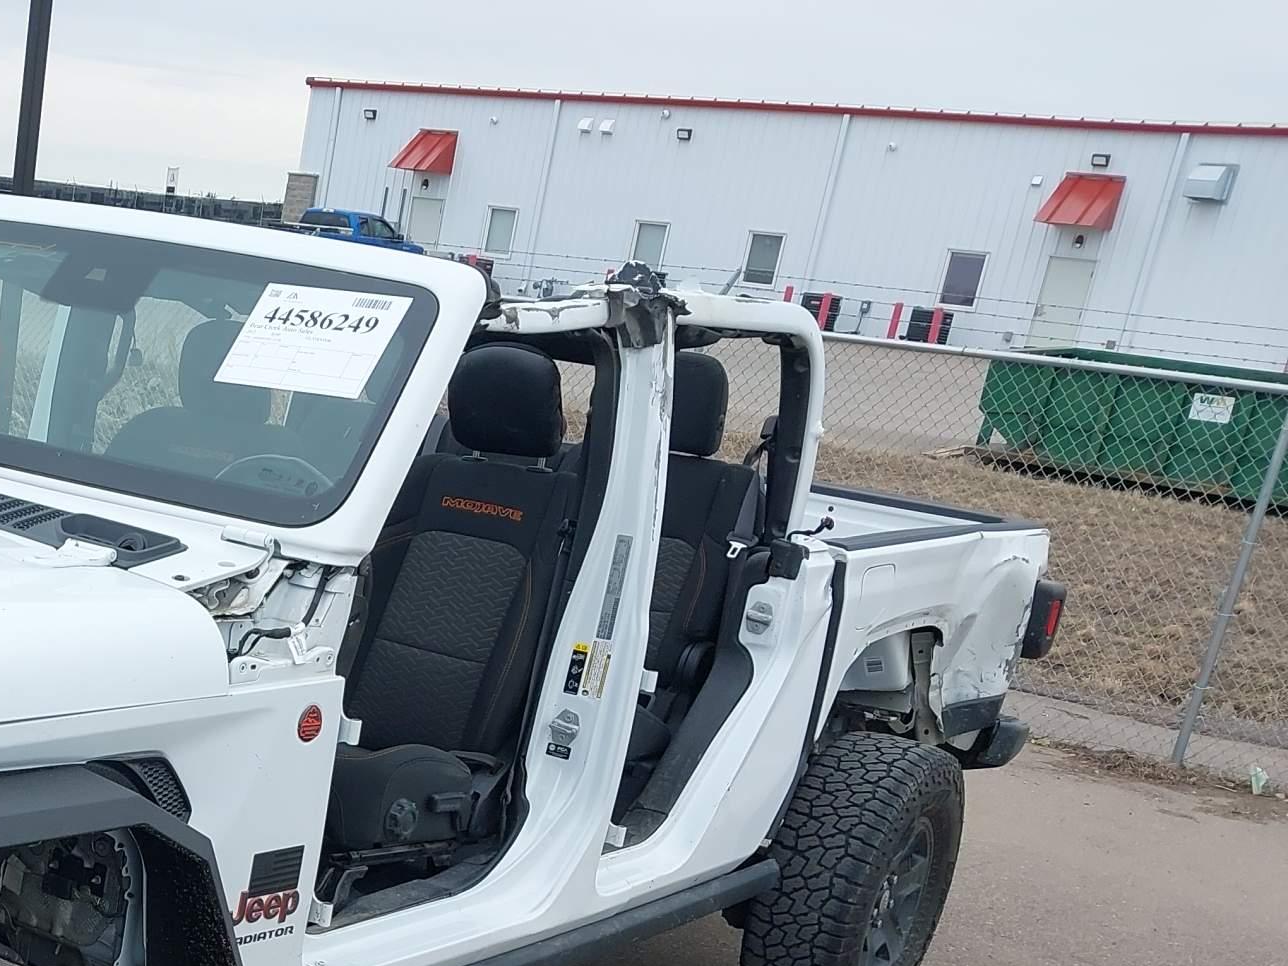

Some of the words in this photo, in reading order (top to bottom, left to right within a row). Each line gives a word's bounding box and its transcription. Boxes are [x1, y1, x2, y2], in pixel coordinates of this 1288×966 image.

[263, 305, 380, 335] 44586249
[442, 496, 523, 521] MOJAVE
[232, 890, 300, 927] Jeep
[235, 925, 294, 946] ADIATOR
